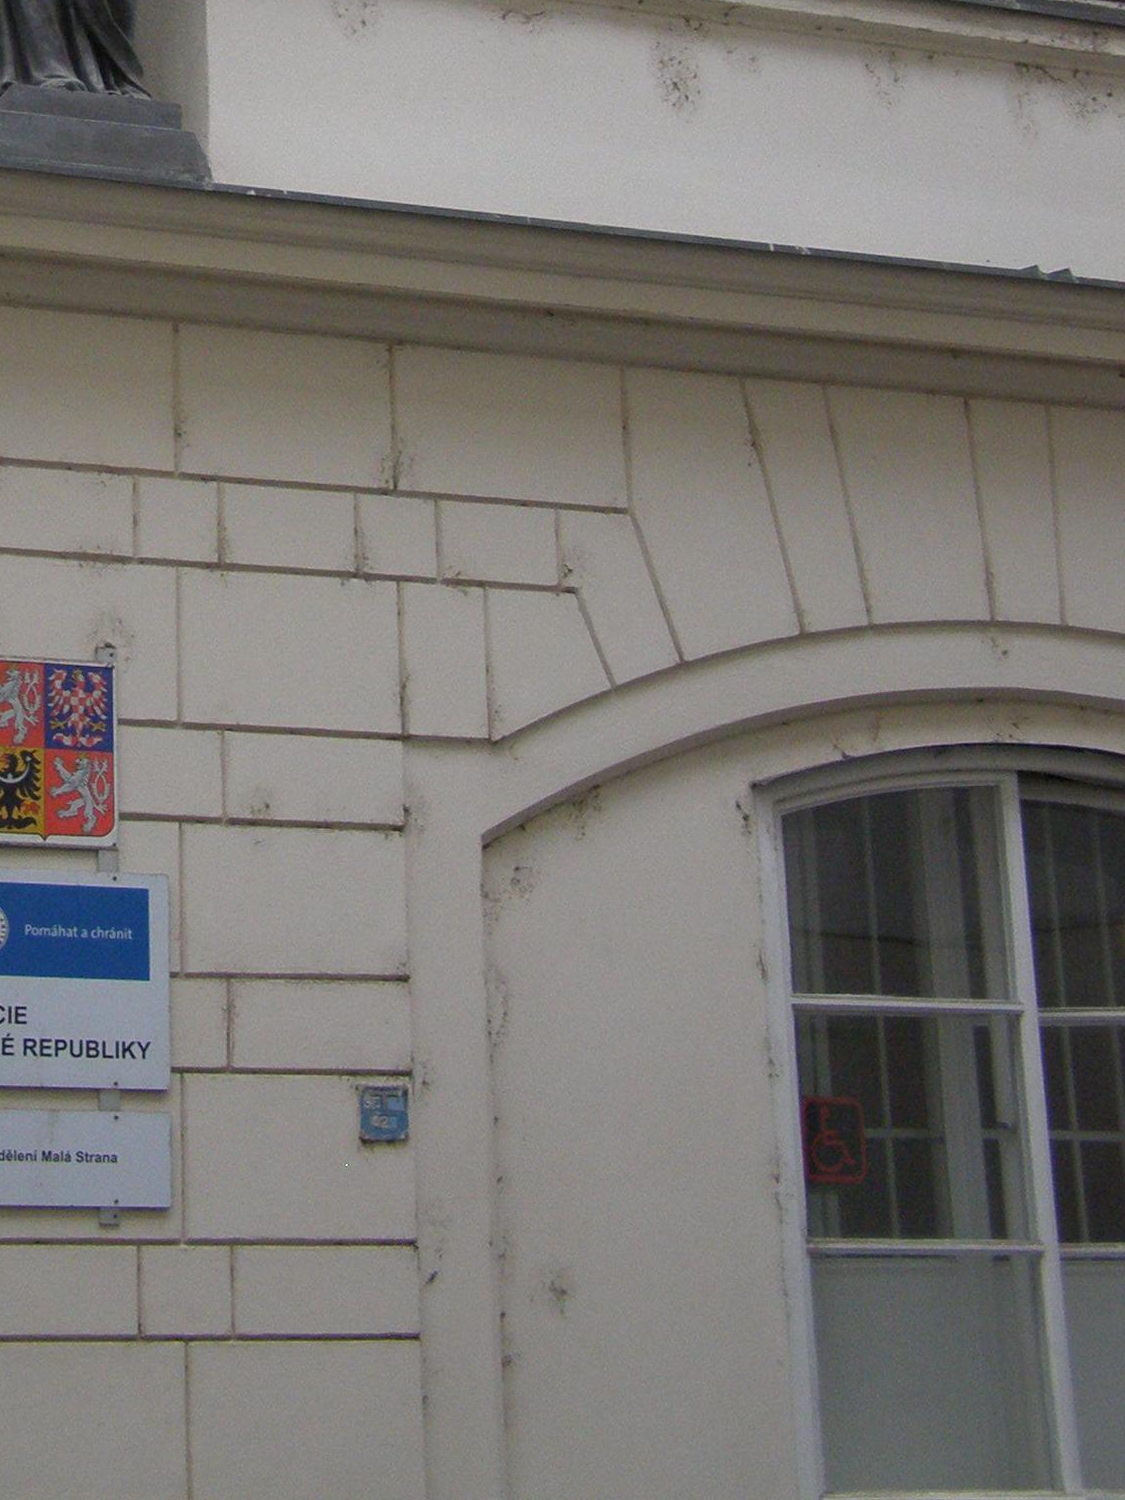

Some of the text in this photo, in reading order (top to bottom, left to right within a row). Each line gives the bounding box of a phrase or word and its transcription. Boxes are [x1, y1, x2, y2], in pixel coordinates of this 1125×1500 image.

[24, 923, 133, 940] Pomáhat a chránit
[23, 1038, 152, 1060] REPUBLIKY
[41, 1150, 72, 1163] Malá
[75, 1151, 118, 1163] Strana
